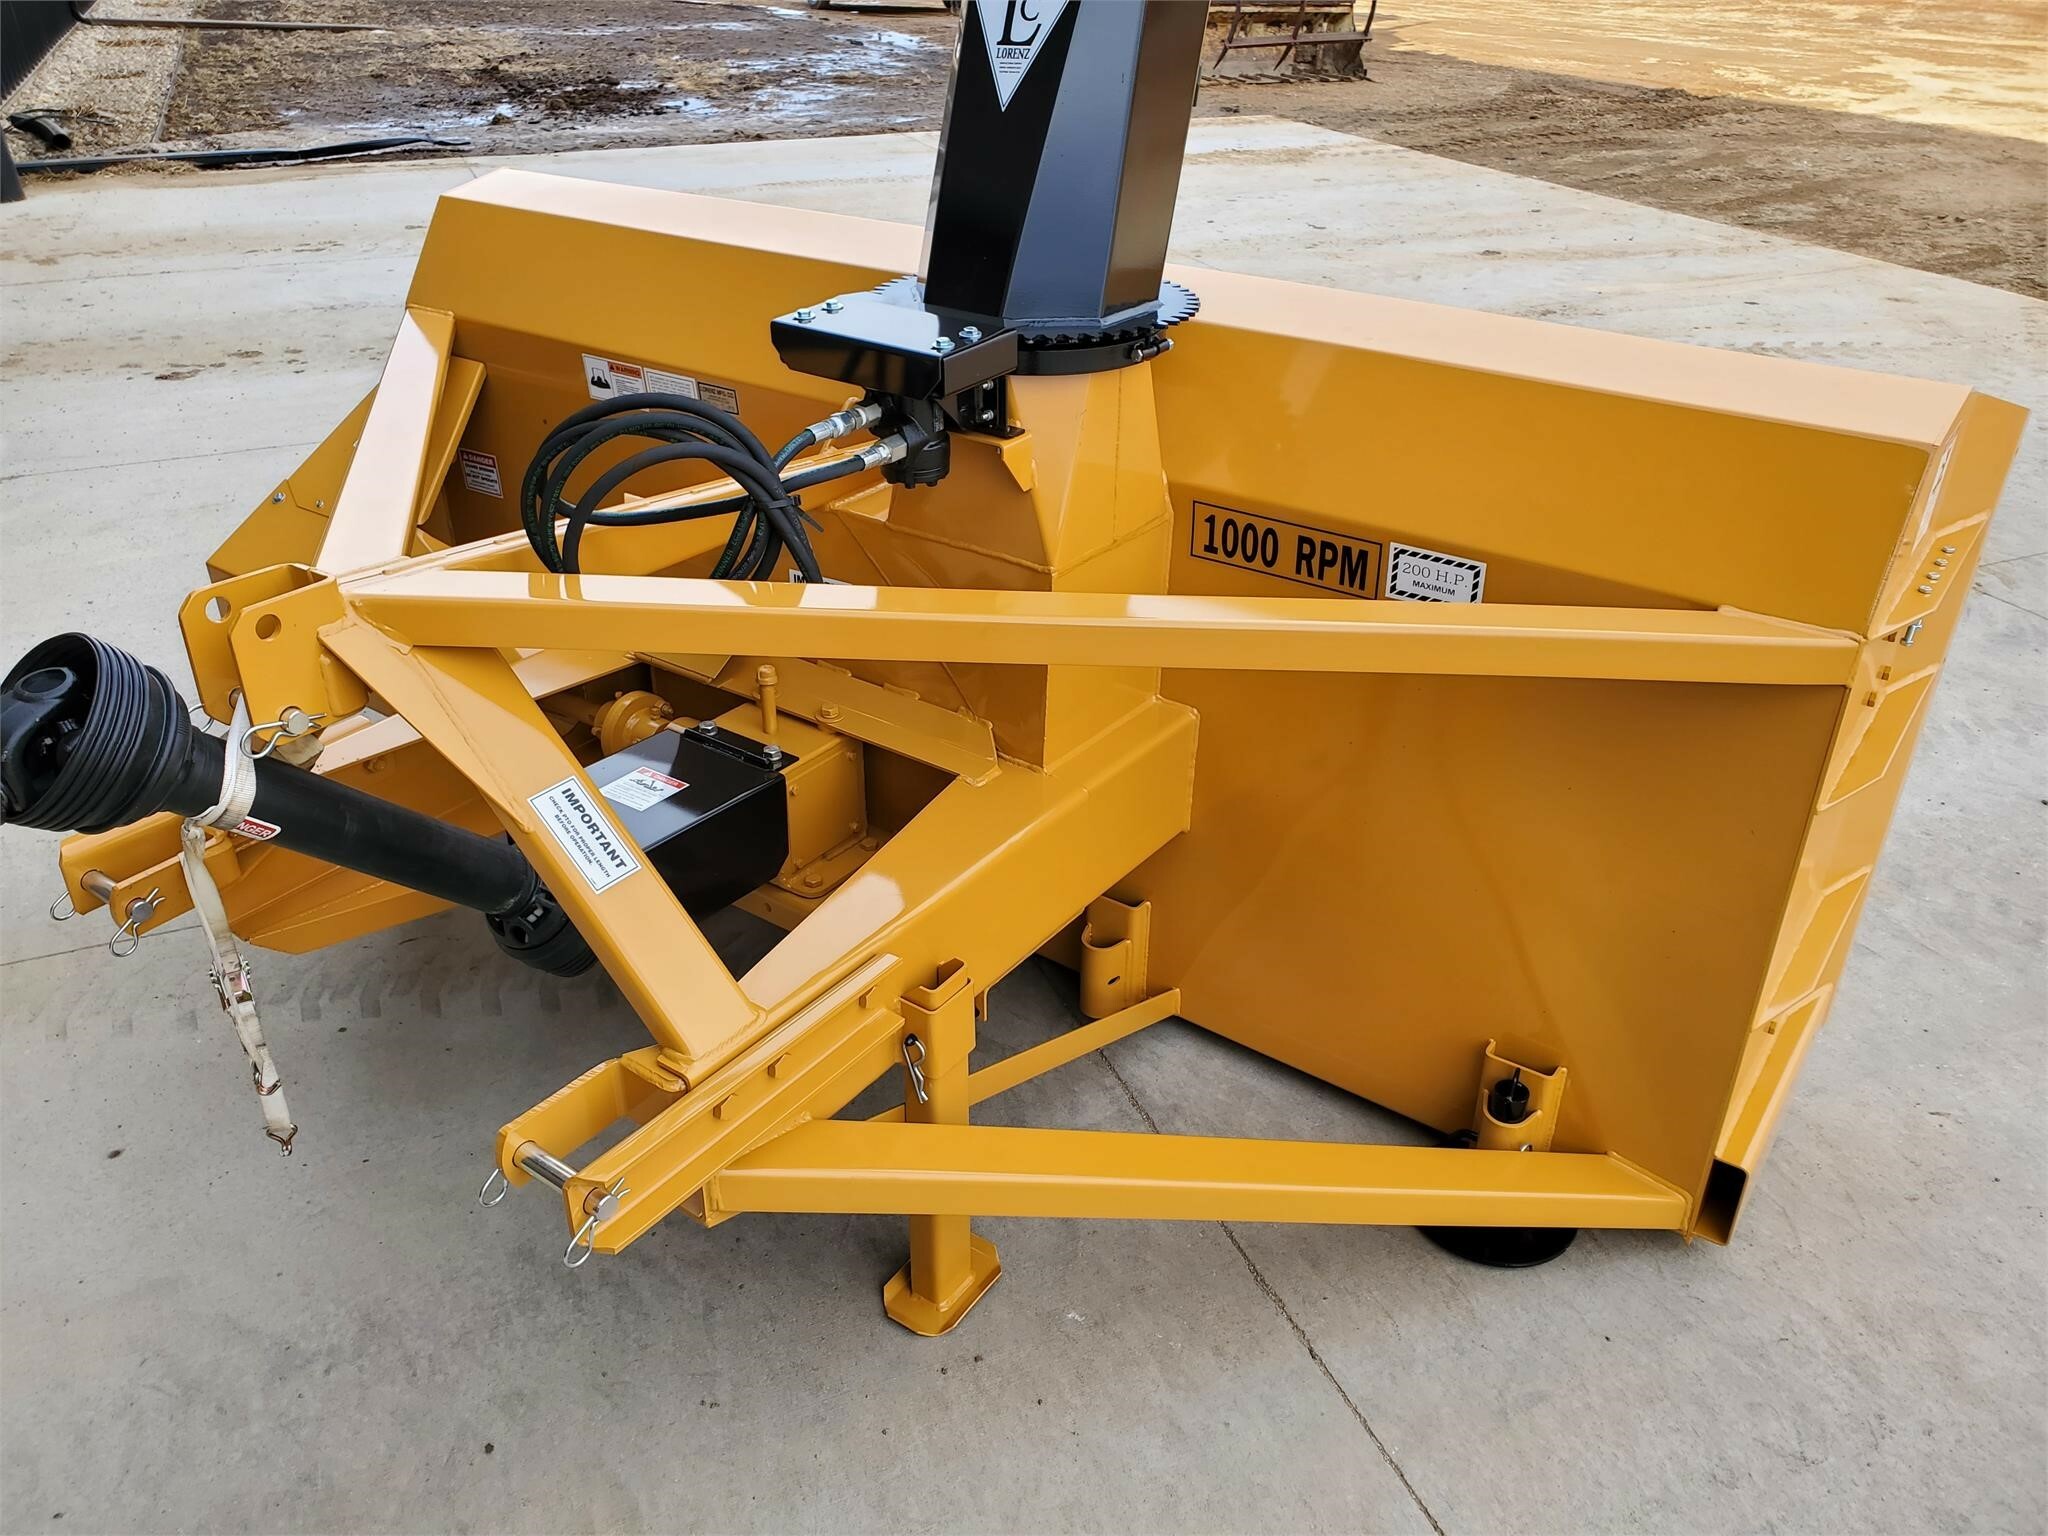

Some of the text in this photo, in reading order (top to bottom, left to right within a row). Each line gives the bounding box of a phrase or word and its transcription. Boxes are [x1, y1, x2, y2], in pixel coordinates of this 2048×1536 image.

[996, 47, 1031, 60] LORENZ
[1203, 514, 1369, 591] 1000 RPM
[1402, 563, 1468, 588] 200 H.P.
[1412, 580, 1456, 596] MAXIMUM
[236, 821, 273, 838] NGER
[554, 814, 571, 834] BEFORE
[561, 787, 627, 868] IMPORTANT
[549, 795, 563, 814] CHECK
[562, 814, 572, 825] PTO
[570, 825, 580, 836] FOR
[579, 836, 596, 857] PROPER
[594, 857, 611, 878] LENGTH
